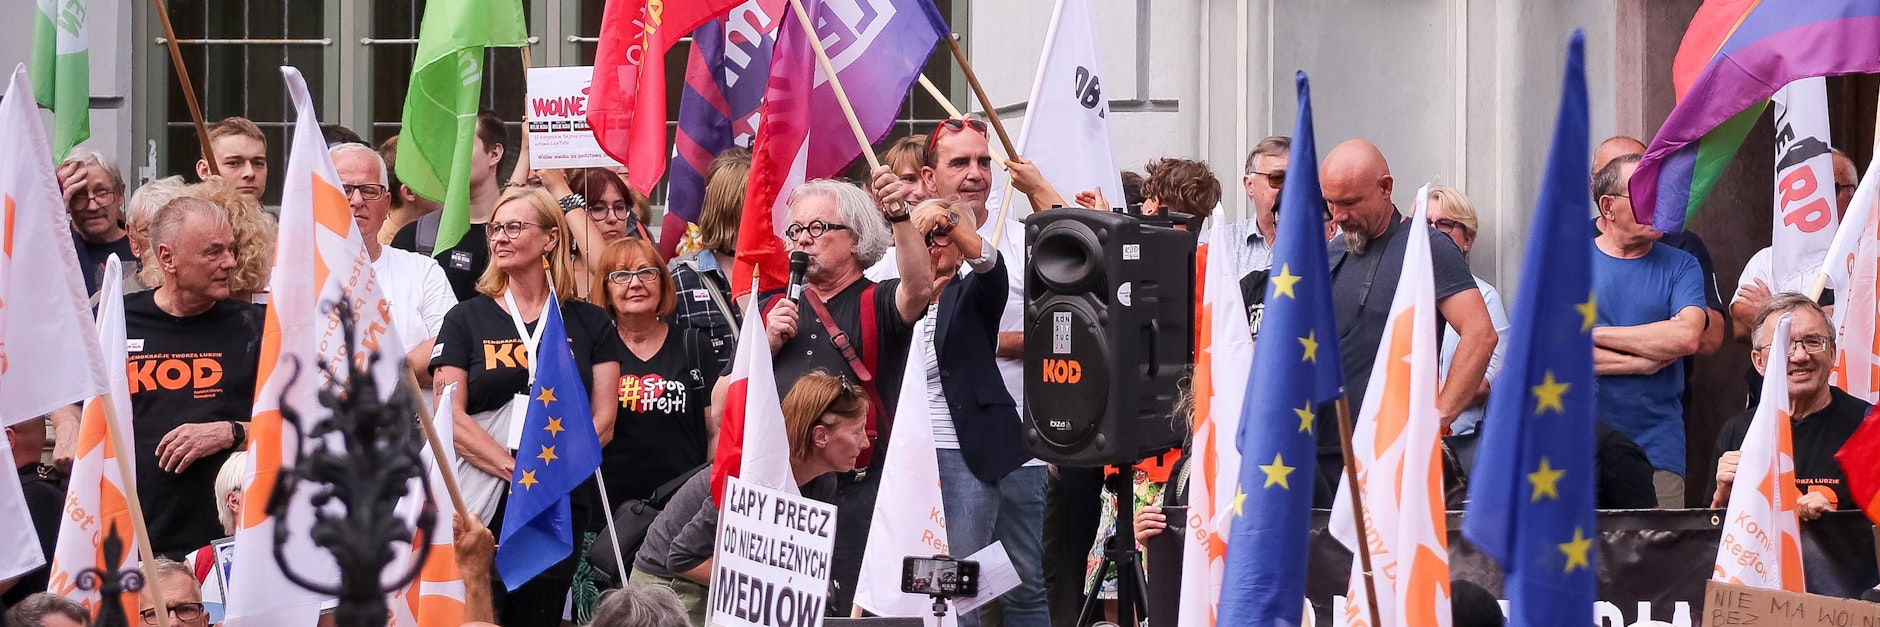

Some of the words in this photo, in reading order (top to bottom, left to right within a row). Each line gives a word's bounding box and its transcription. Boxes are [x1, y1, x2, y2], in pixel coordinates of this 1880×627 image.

[532, 96, 586, 118] WOLNE
[1778, 164, 1832, 233] RP
[127, 358, 223, 395] KOD
[1043, 358, 1082, 384] KOD
[1814, 477, 1840, 485] LUDZIE
[730, 483, 768, 521] ŁAPY
[773, 497, 831, 539] PRECZ
[723, 524, 737, 554] OD
[739, 529, 828, 581] NIEZALEŻNYCH
[716, 566, 822, 627] MEDIÓW
[1714, 590, 1753, 609] NIE
[1770, 597, 1805, 619] MA
[1712, 608, 1759, 627] BEZ
